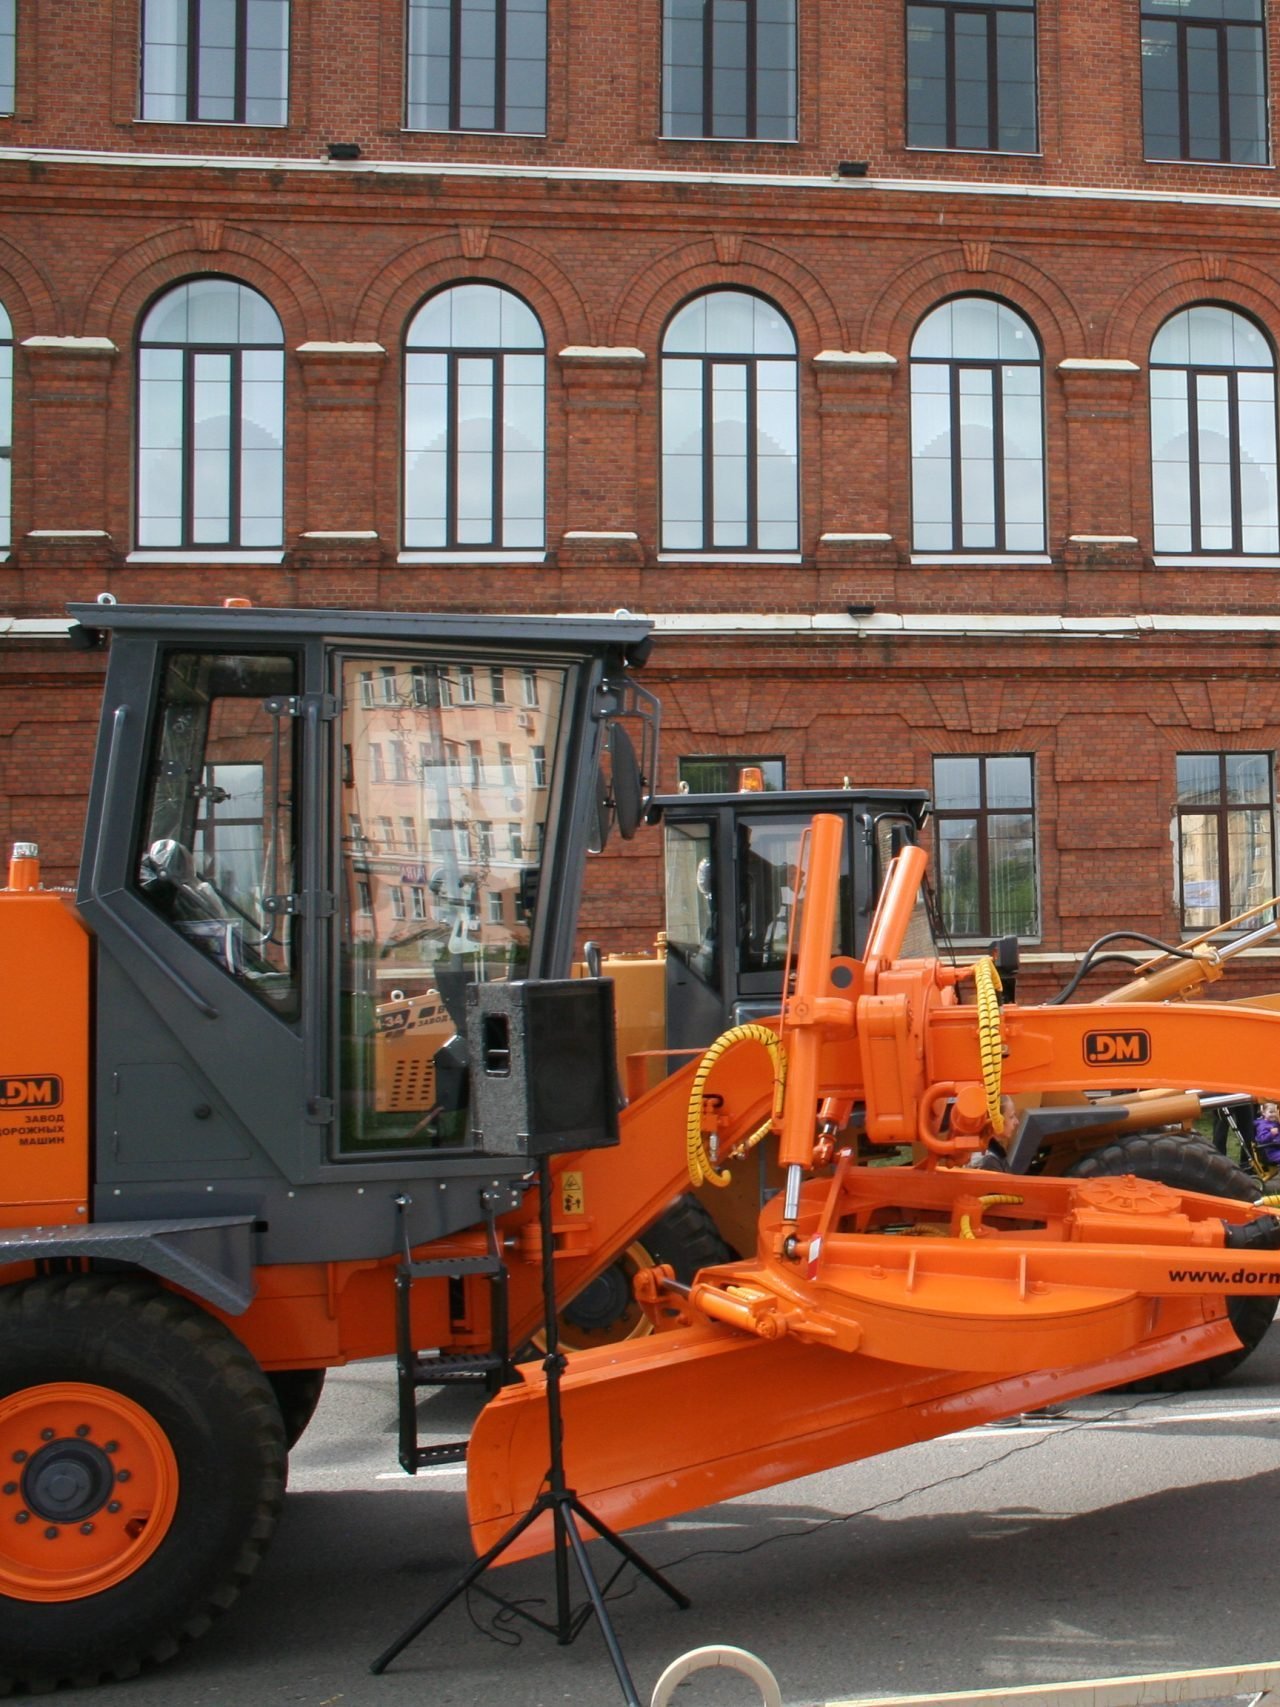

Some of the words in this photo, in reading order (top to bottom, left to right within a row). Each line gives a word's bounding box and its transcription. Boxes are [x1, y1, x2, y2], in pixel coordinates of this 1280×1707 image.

[25, 1114, 65, 1124] ЗАВОД
[0, 1126, 65, 1137] ОРОЖНЫХ
[19, 1136, 65, 1146] МАШИН
